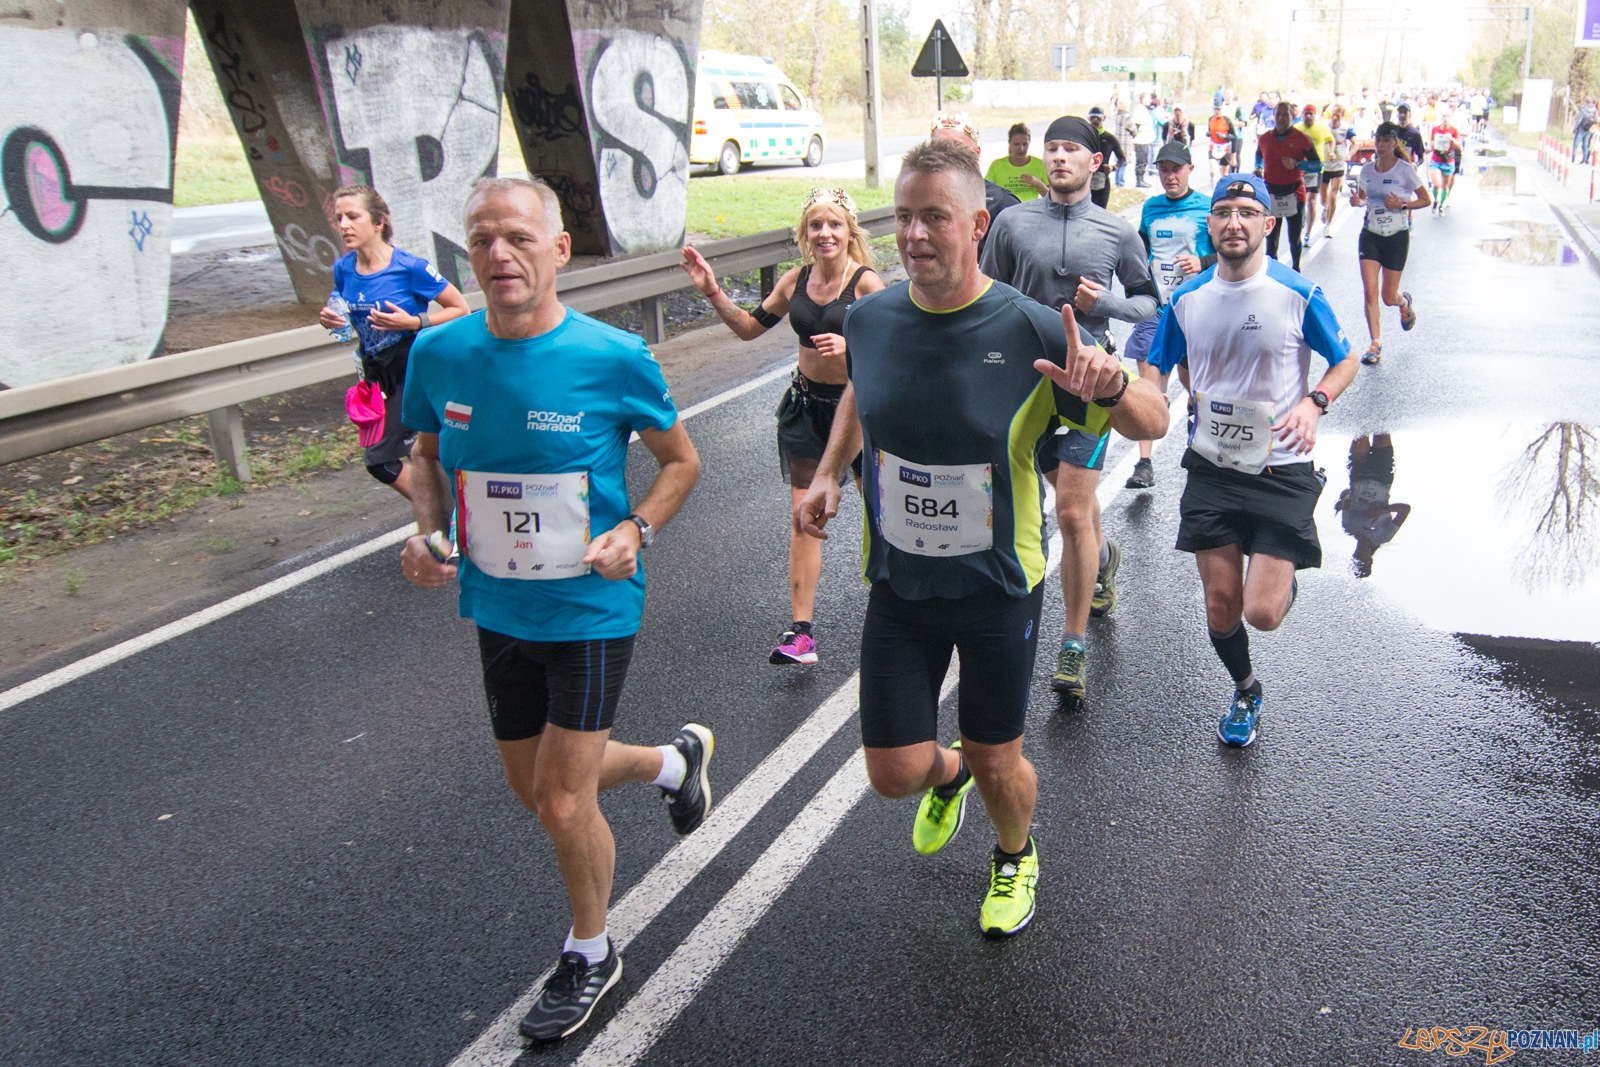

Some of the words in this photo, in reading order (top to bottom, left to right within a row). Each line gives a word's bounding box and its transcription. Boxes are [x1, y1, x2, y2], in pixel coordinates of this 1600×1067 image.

[1377, 216, 1393, 224] 525
[1164, 276, 1184, 285] 572
[444, 419, 469, 431] POLAND
[526, 421, 580, 433] maraton
[1211, 420, 1254, 441] 3775
[905, 494, 959, 519] 684
[503, 511, 541, 533] 121
[905, 519, 958, 532] Radosław
[513, 539, 533, 549] Jan
